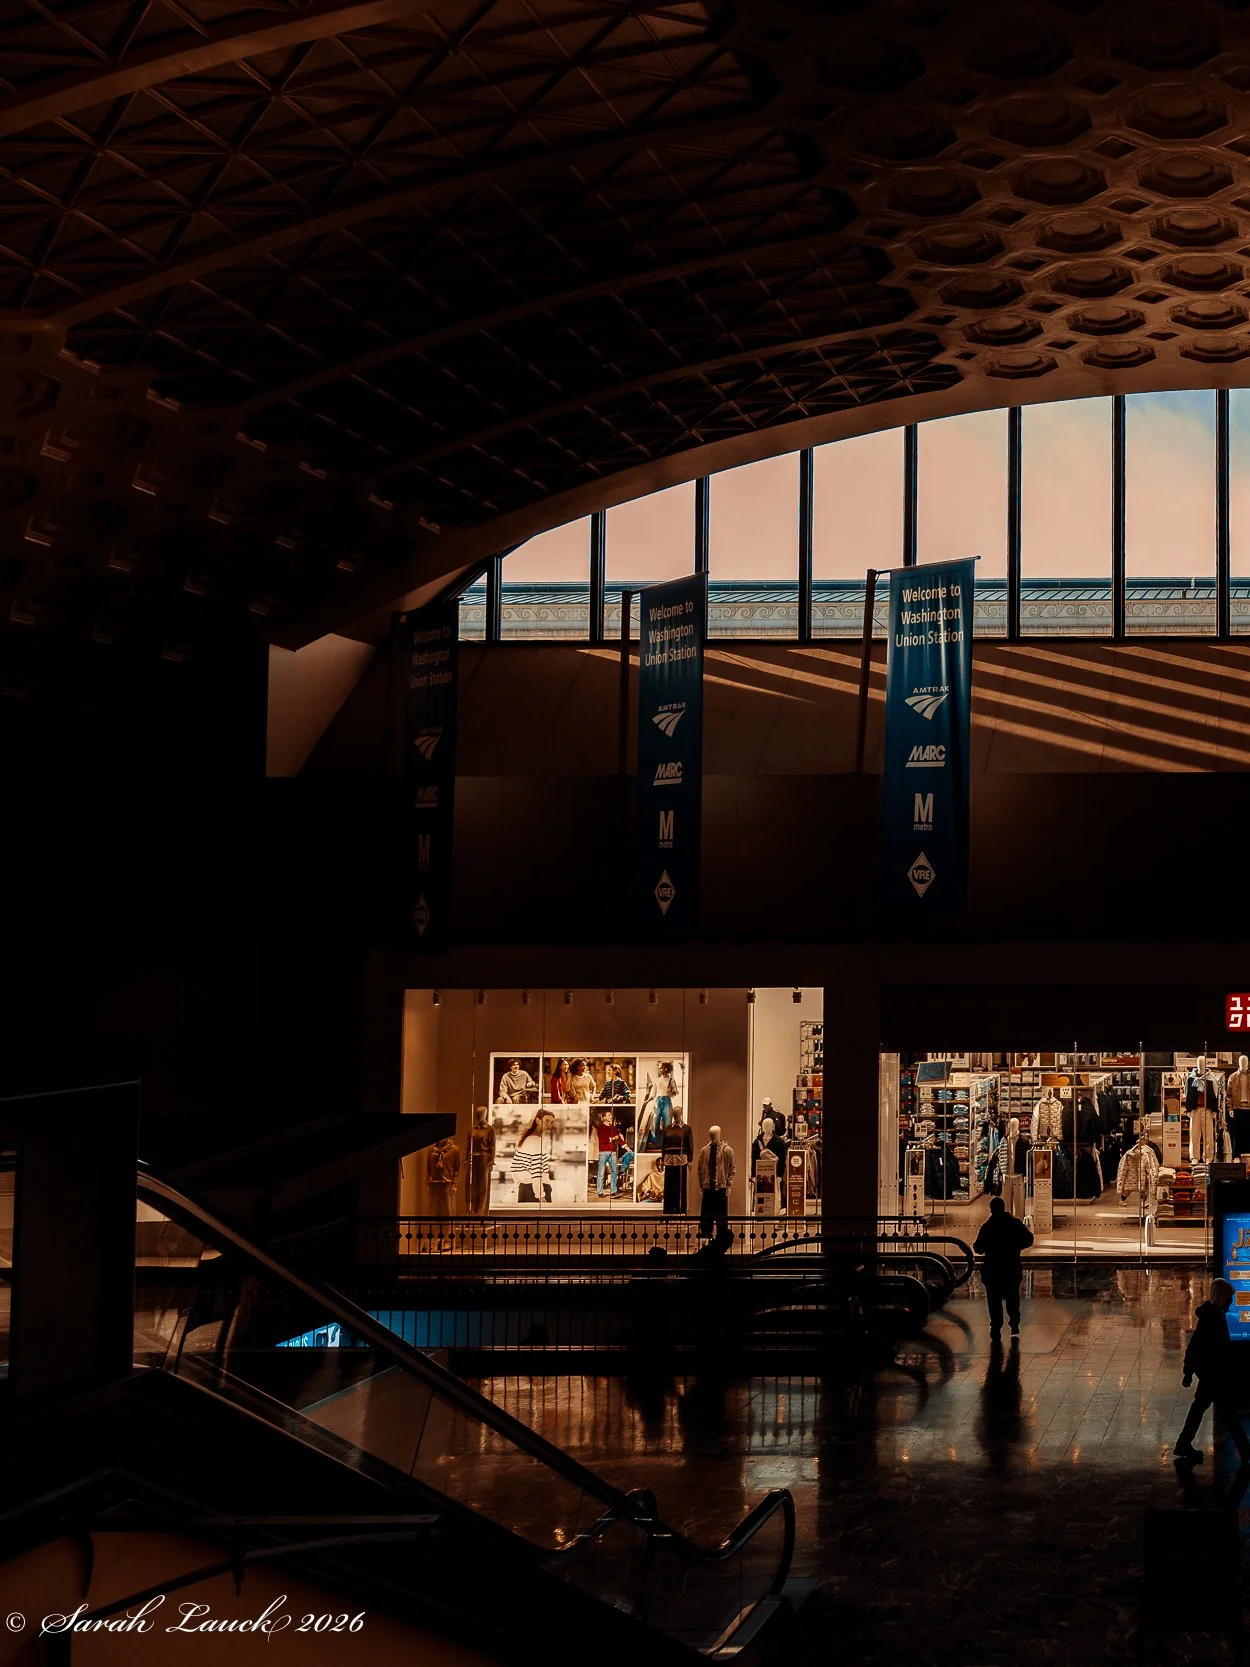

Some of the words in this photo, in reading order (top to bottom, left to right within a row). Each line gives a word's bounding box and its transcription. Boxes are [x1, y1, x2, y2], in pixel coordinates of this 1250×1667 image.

[902, 586, 947, 603] Welcome
[950, 584, 961, 596] to
[649, 604, 683, 621] Welcome
[684, 600, 694, 614] to
[901, 607, 961, 625] Washington
[648, 624, 694, 644] Washington
[895, 632, 925, 648] Union
[927, 628, 964, 645] Station
[645, 650, 667, 667] Union
[669, 645, 697, 662] Station
[912, 685, 950, 694] AMTRAK
[658, 701, 687, 712] AMTRAK
[908, 744, 946, 761] MARC
[655, 761, 683, 779] MARC
[913, 793, 934, 823] M
[659, 809, 675, 841] M
[913, 823, 933, 831] metro
[912, 869, 931, 880] VRE
[658, 887, 673, 898] VRE
